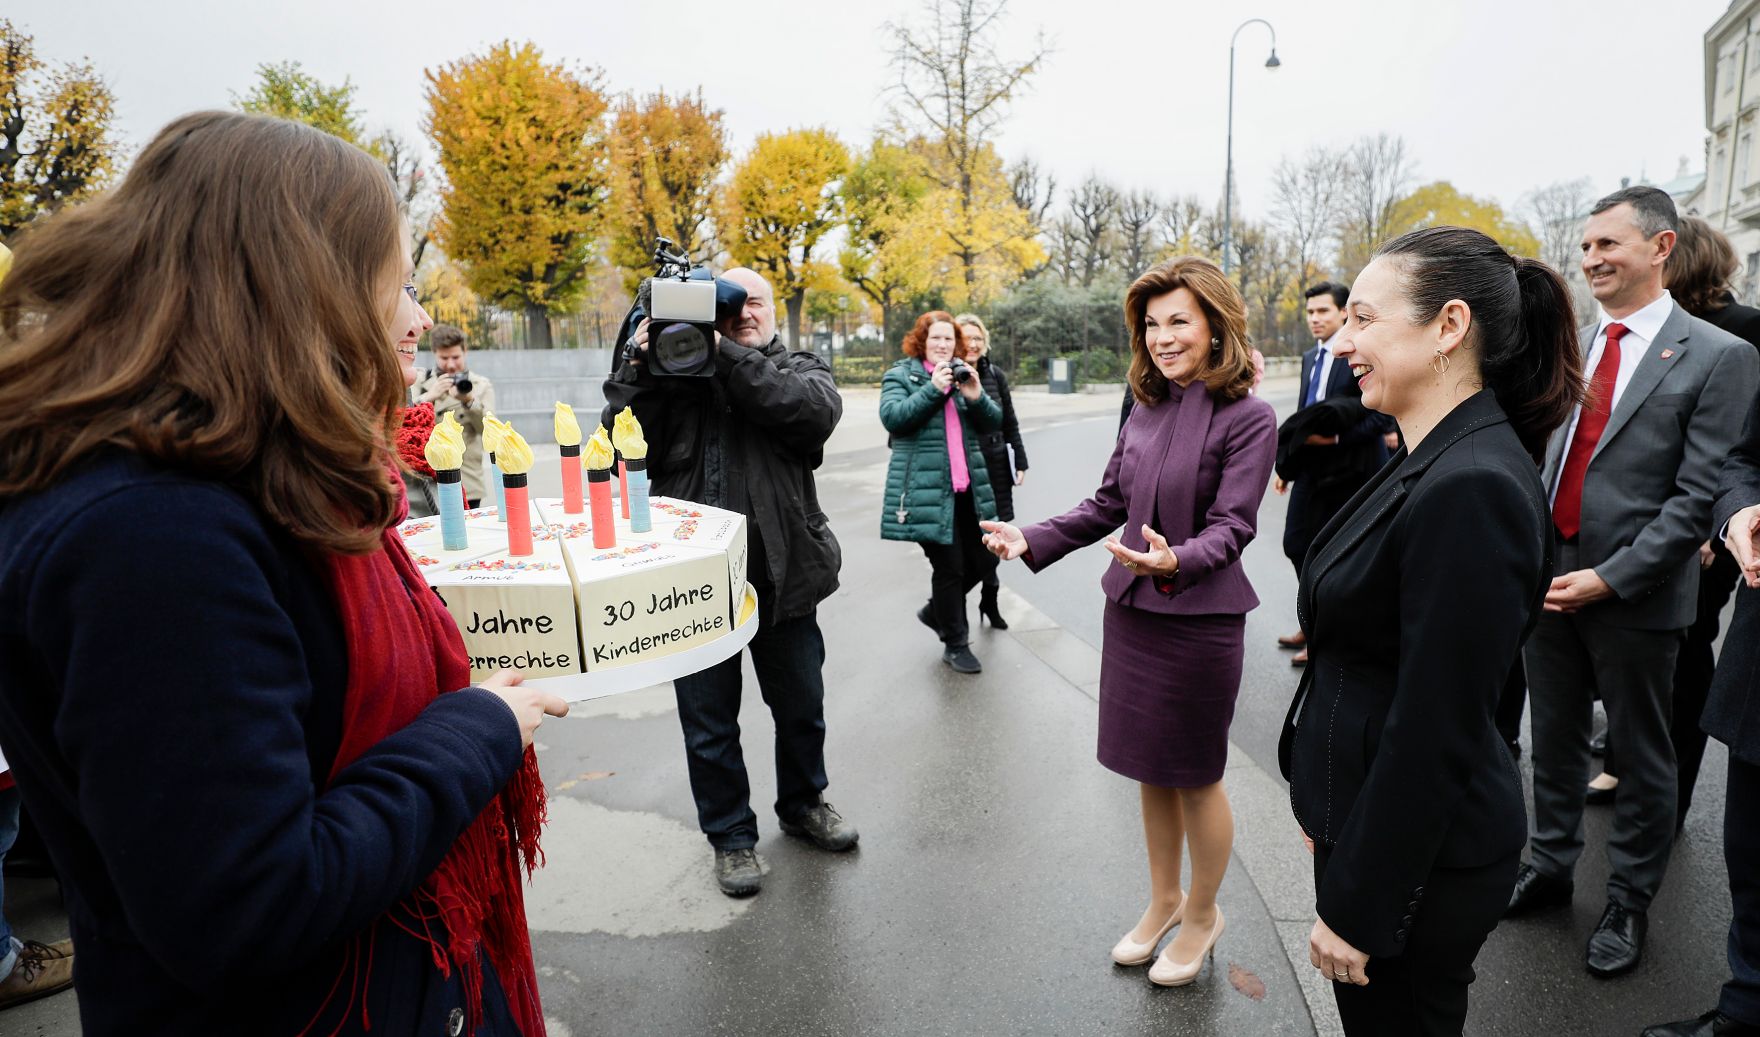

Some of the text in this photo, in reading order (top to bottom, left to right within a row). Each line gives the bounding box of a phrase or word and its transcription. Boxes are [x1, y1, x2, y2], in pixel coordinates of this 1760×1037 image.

[467, 610, 553, 634] Jahre
[603, 600, 635, 626] 30
[647, 584, 713, 614] Jahre
[593, 616, 723, 663] Kinderrechte
